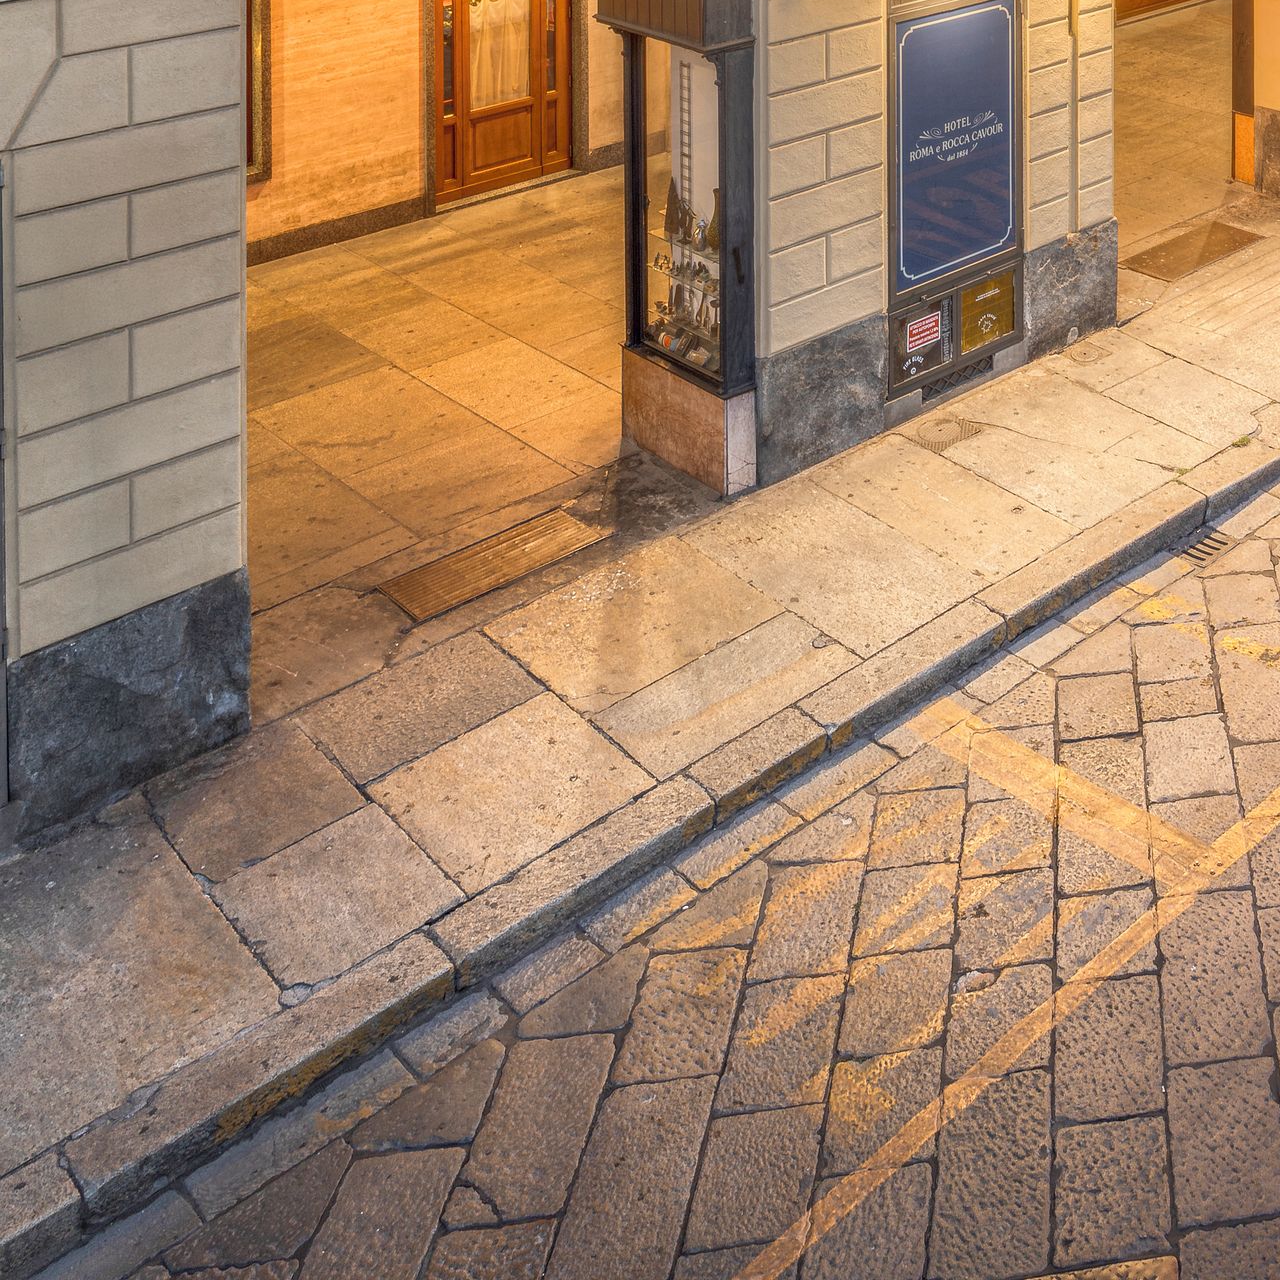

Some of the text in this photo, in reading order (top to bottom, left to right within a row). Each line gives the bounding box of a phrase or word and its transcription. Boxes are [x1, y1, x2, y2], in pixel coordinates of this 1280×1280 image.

[944, 116, 971, 133] HOTEL
[909, 145, 934, 162] ROMA
[942, 136, 970, 151] ROCCA
[971, 122, 1003, 141] CAVOUR
